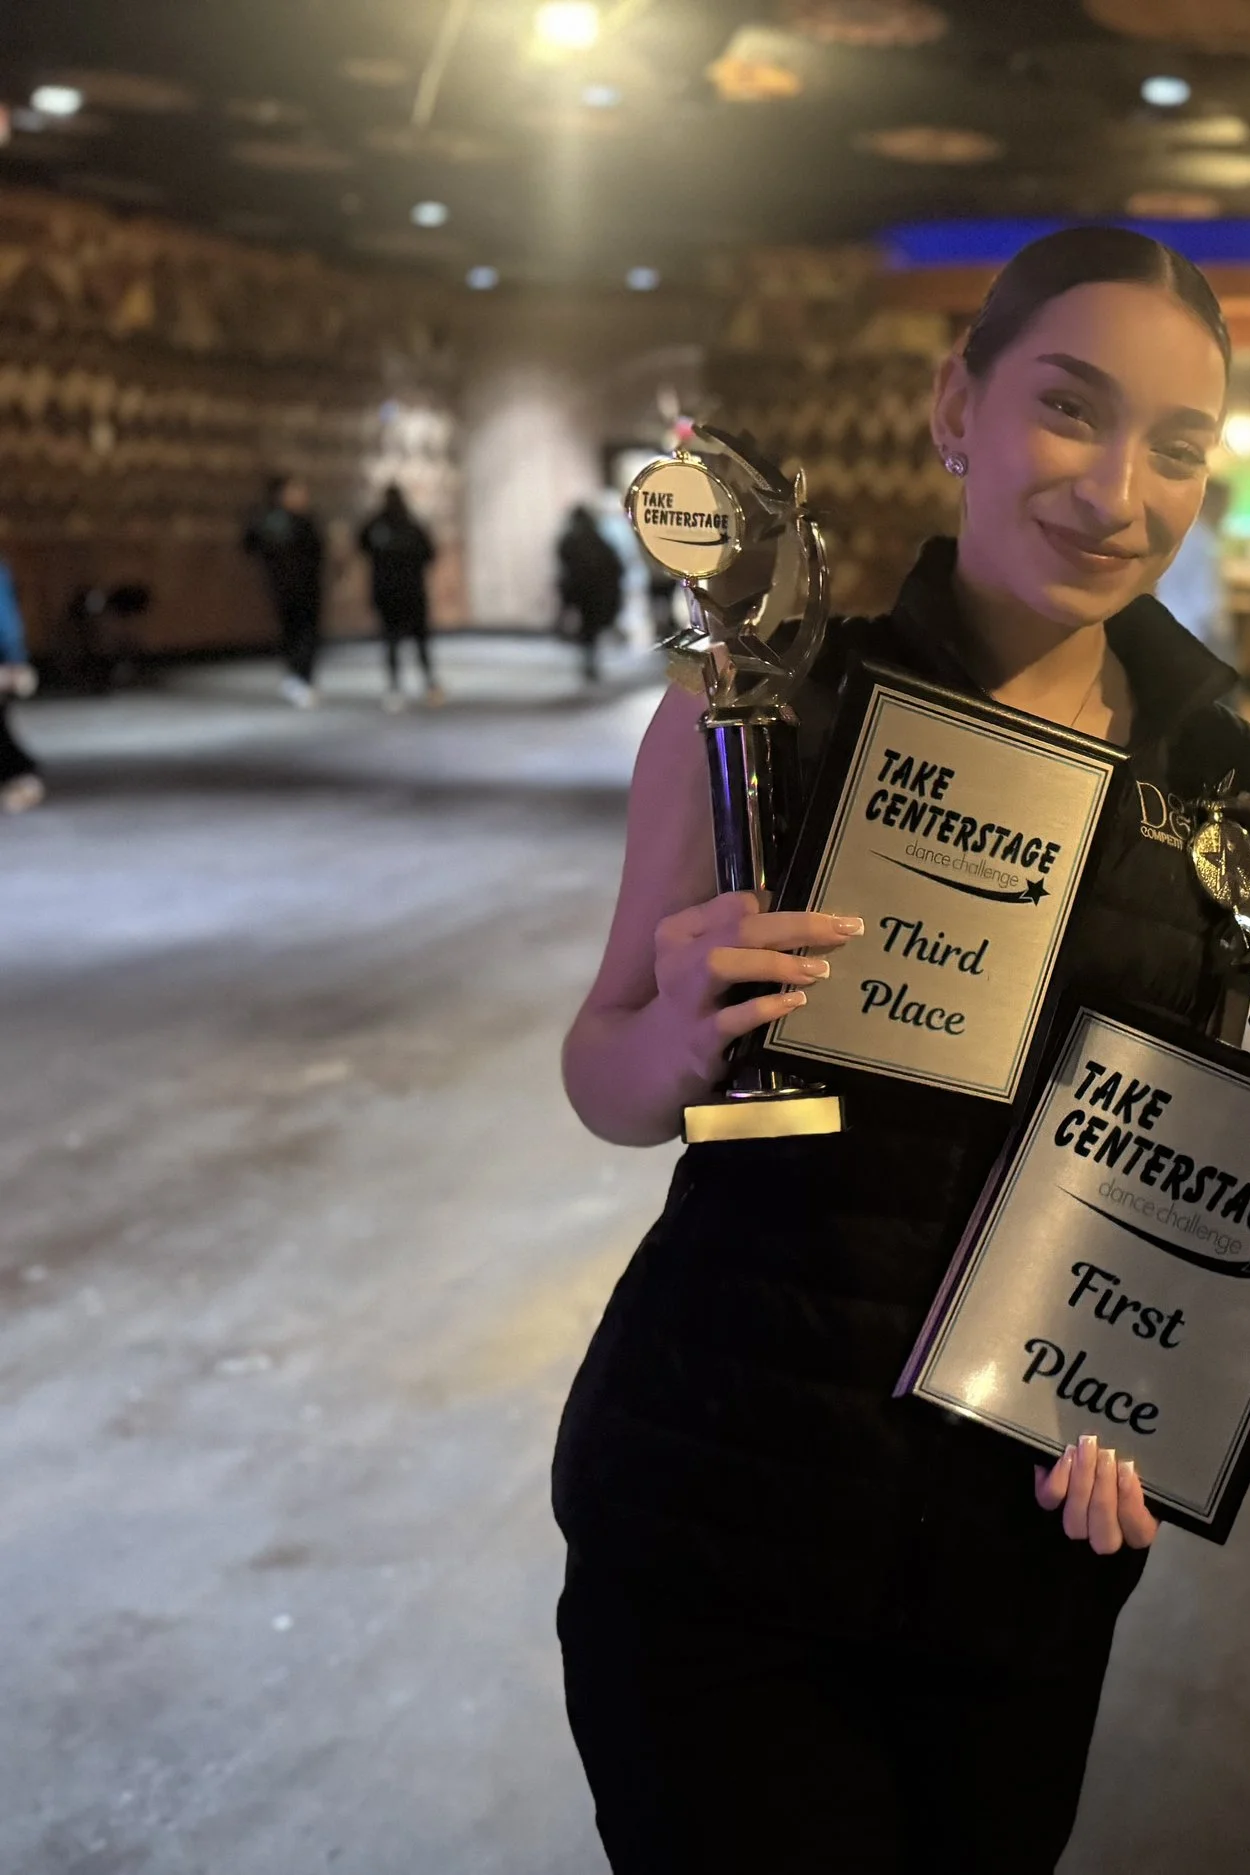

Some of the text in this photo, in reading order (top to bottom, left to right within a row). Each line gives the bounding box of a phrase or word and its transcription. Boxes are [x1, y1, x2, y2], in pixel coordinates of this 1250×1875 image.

[642, 491, 674, 508] TAKE
[644, 509, 729, 530] CENTERSTAGE
[877, 749, 955, 800] TAKE
[865, 789, 1062, 874] CENTERSTAGE
[906, 840, 1019, 889] dance challenge
[879, 915, 990, 976] Third
[860, 979, 967, 1036] Place
[1073, 1060, 1172, 1130] TAKE
[1098, 1177, 1243, 1256] dance challenge
[1066, 1260, 1186, 1350] First
[1021, 1338, 1160, 1436] Place
